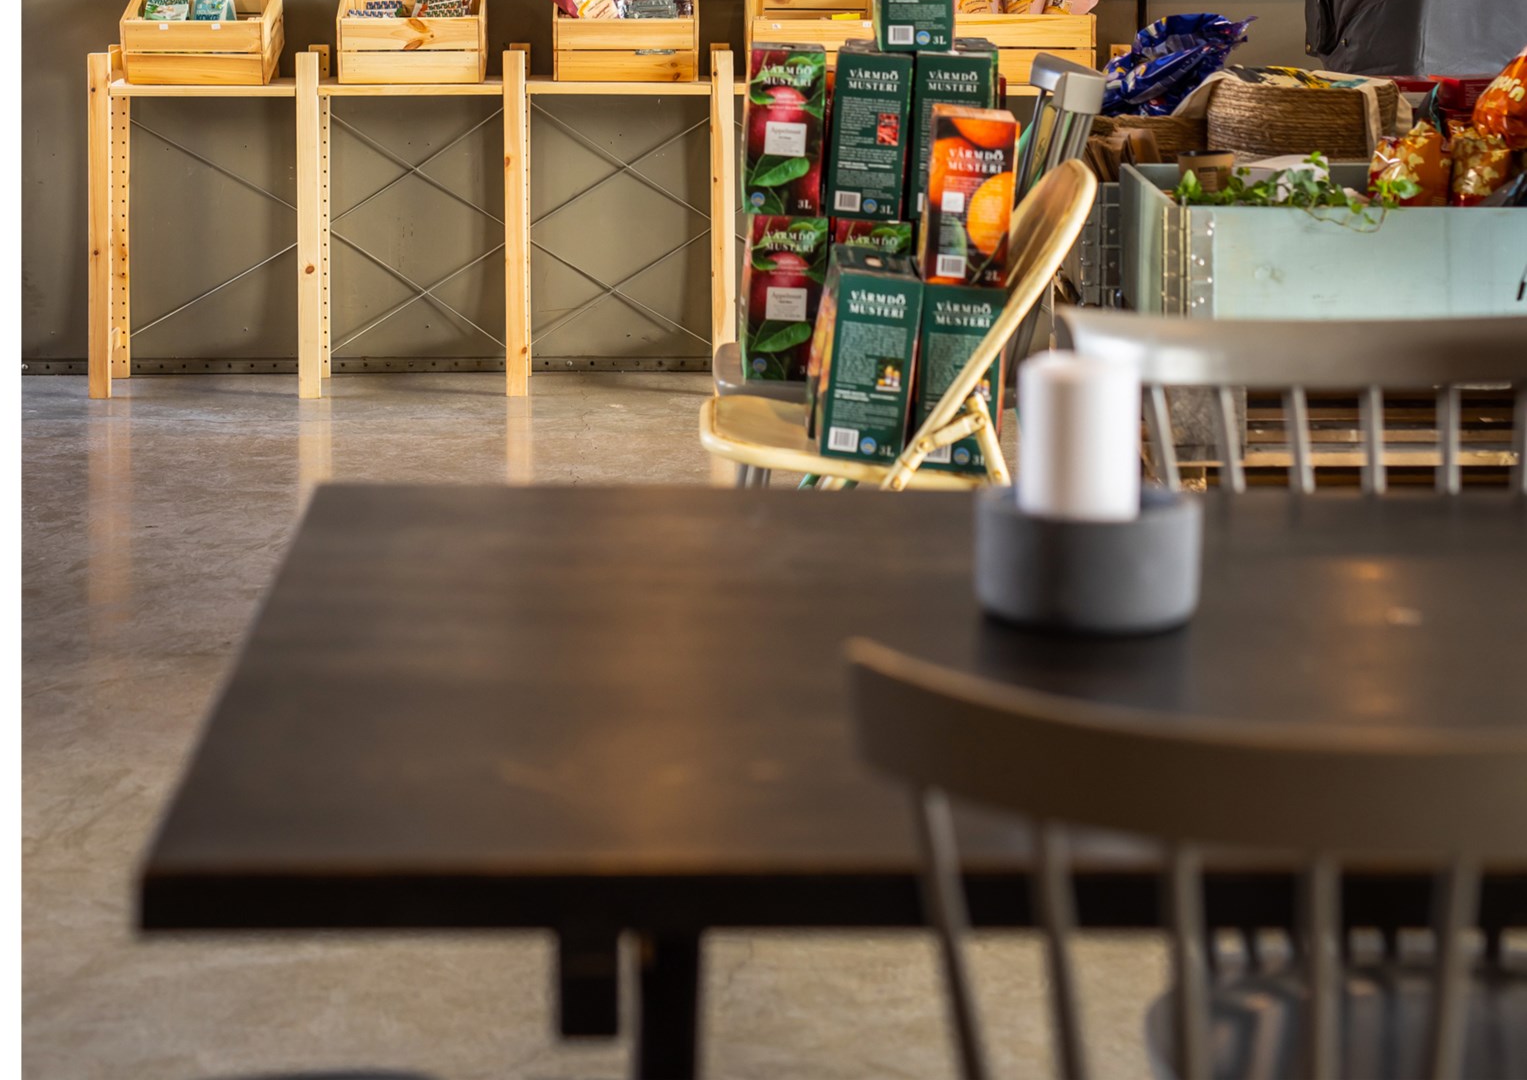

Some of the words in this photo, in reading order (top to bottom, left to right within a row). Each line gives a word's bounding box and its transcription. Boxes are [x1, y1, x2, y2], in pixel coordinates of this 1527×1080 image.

[932, 35, 947, 45] 3L
[763, 76, 813, 87] MUSTERI
[848, 80, 898, 92] MUSTERI
[928, 82, 978, 93] MUSTERI
[947, 160, 1003, 174] MUSTERI
[765, 242, 815, 253] MUSTERI
[849, 302, 905, 319] MUSTERI
[935, 314, 991, 328] MUSTERI
